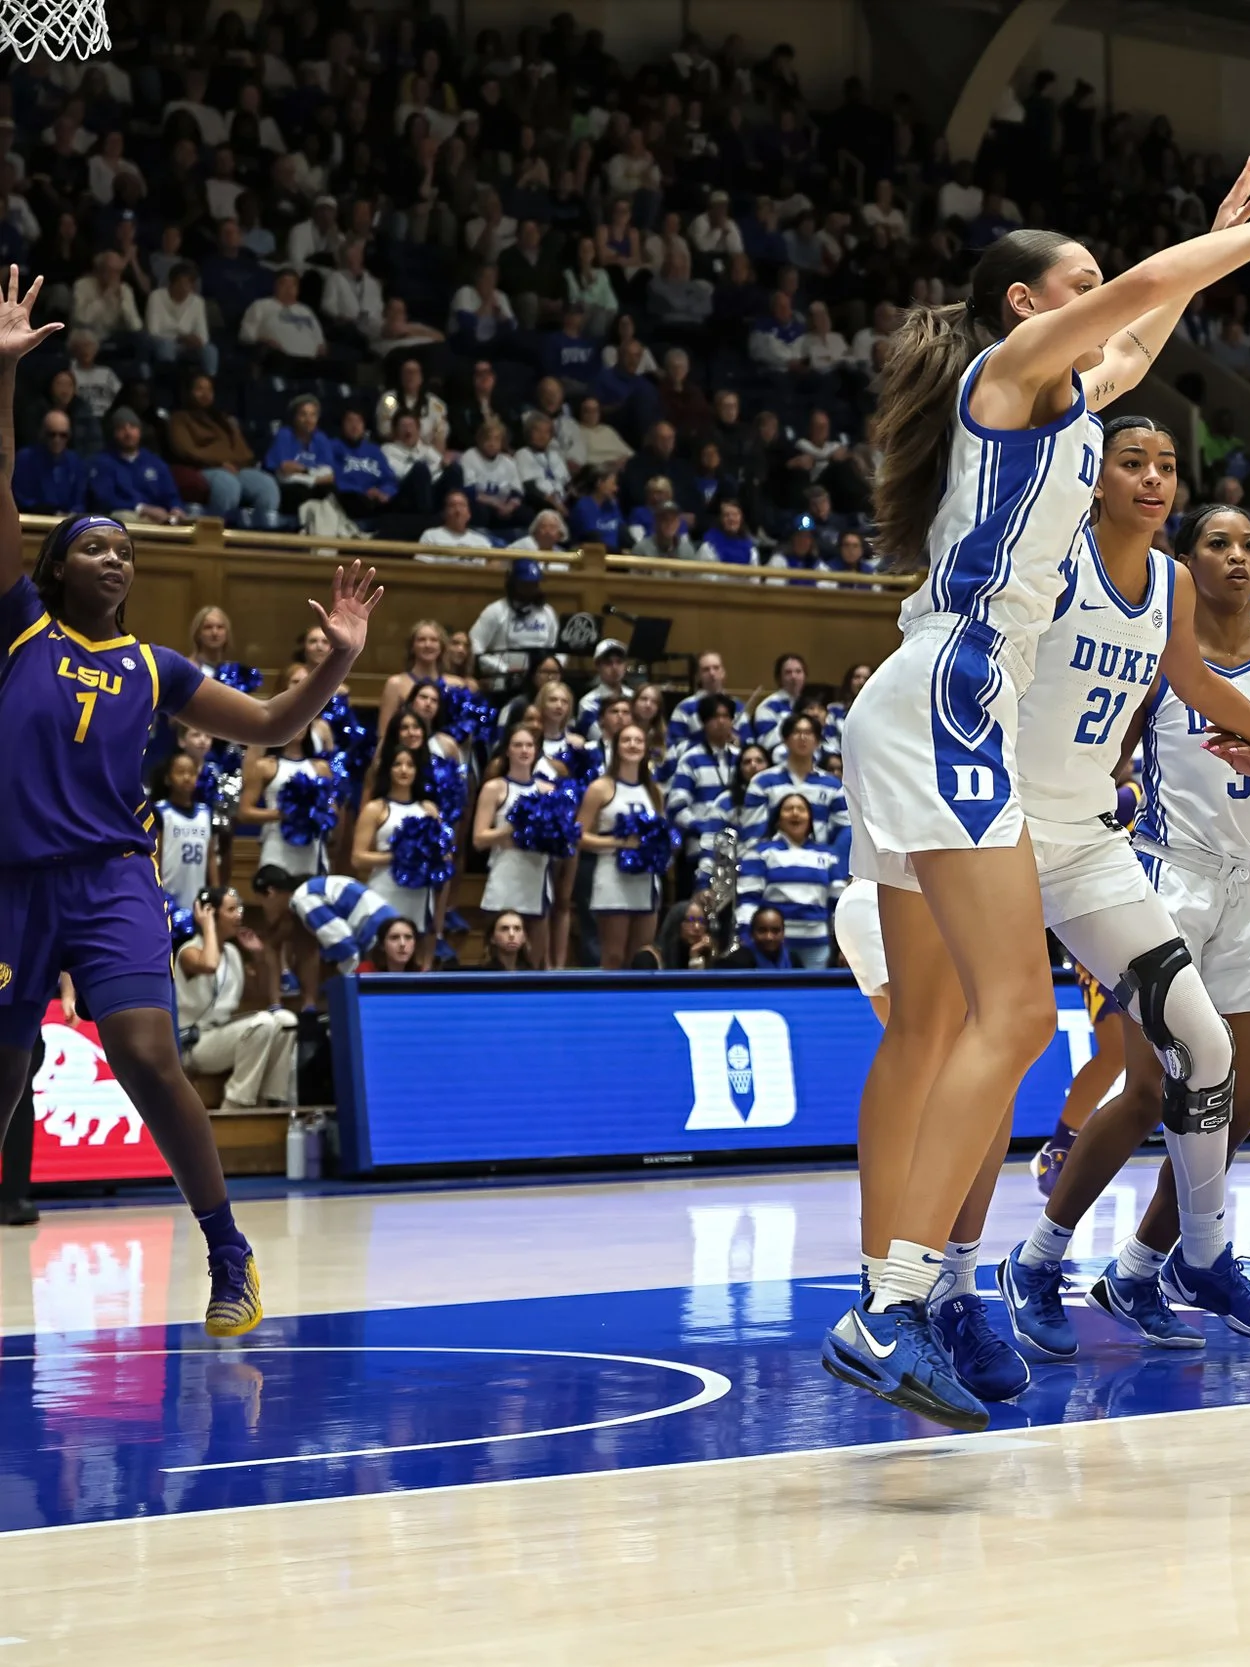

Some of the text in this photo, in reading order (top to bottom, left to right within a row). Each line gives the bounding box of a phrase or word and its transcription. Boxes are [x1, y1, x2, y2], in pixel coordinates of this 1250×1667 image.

[57, 657, 122, 695] LSU
[1069, 634, 1158, 686] DUKE
[74, 691, 97, 743] 1
[1074, 687, 1128, 745] 21
[952, 765, 994, 800] D
[673, 1009, 797, 1131] D
